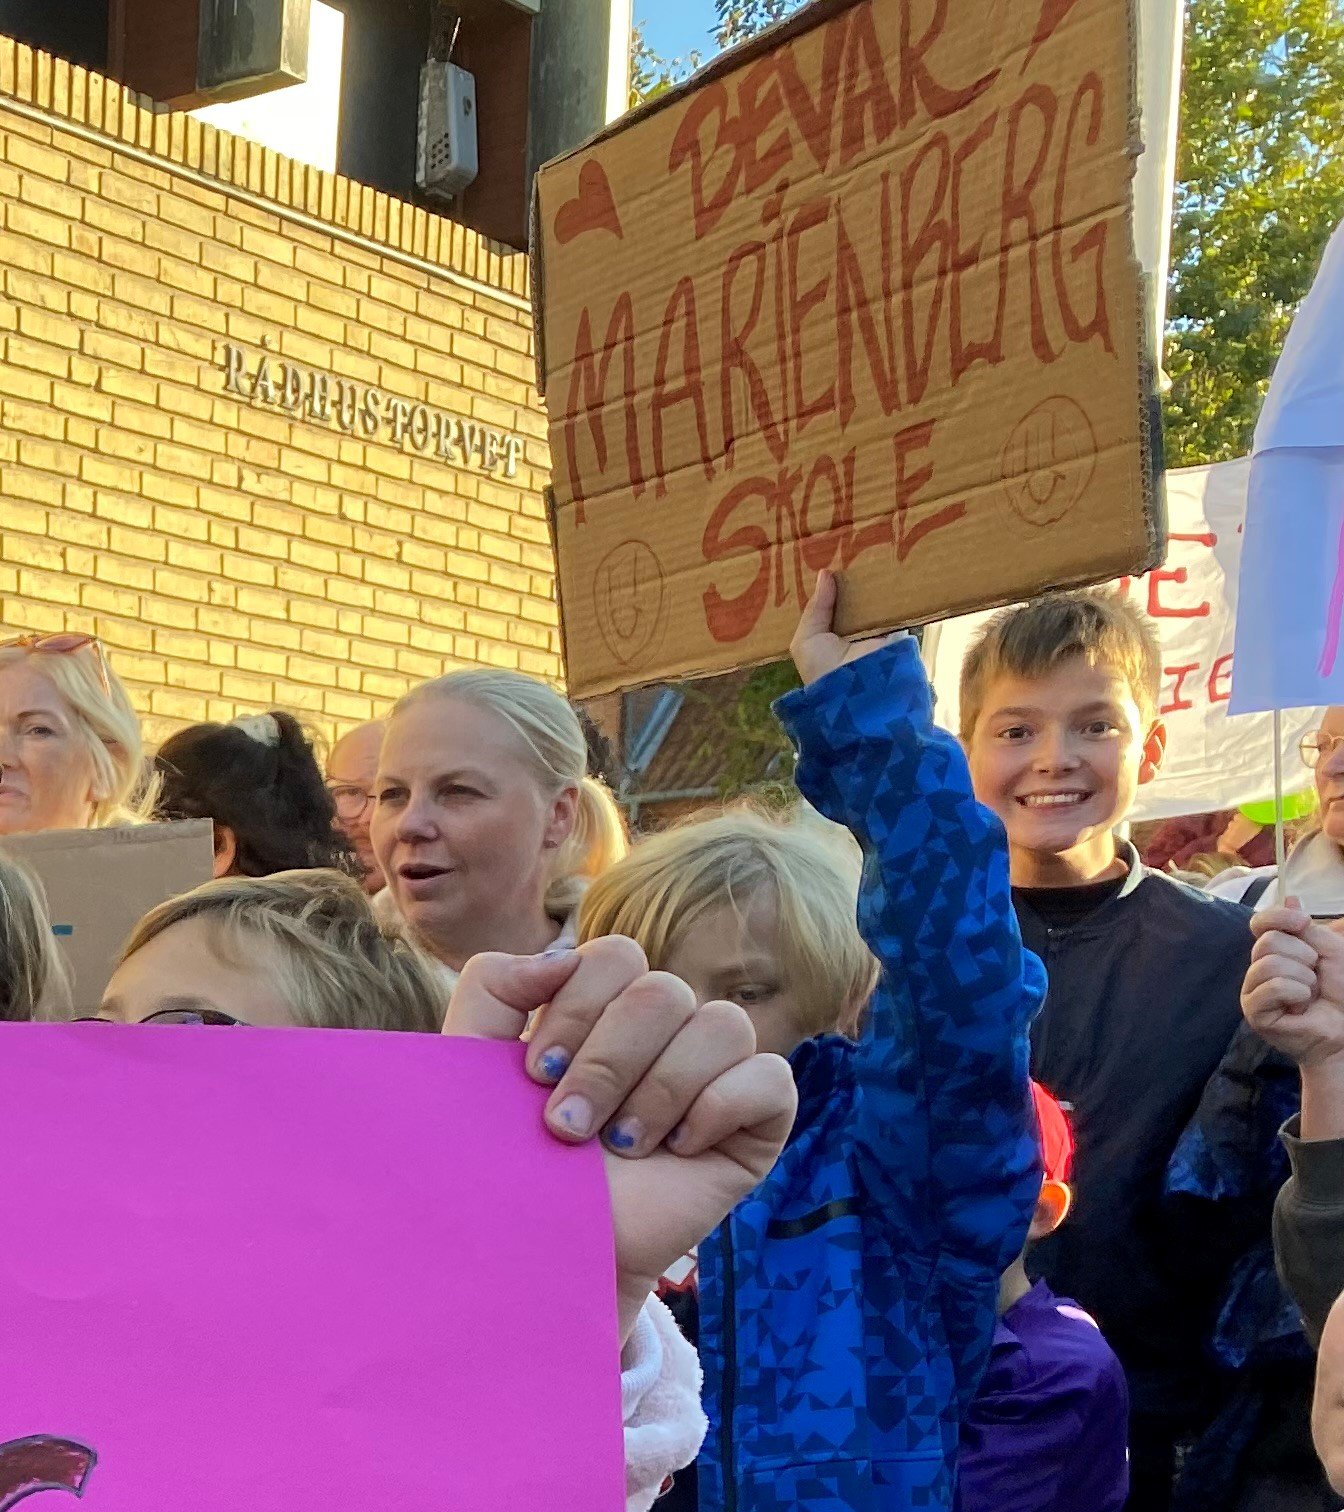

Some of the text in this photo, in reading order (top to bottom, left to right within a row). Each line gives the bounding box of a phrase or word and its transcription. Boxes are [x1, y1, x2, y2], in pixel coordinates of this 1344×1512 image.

[669, 0, 1001, 239] BEVAR
[223, 335, 525, 478] RÅDHUSTORVET
[702, 418, 967, 642] SKOLE
